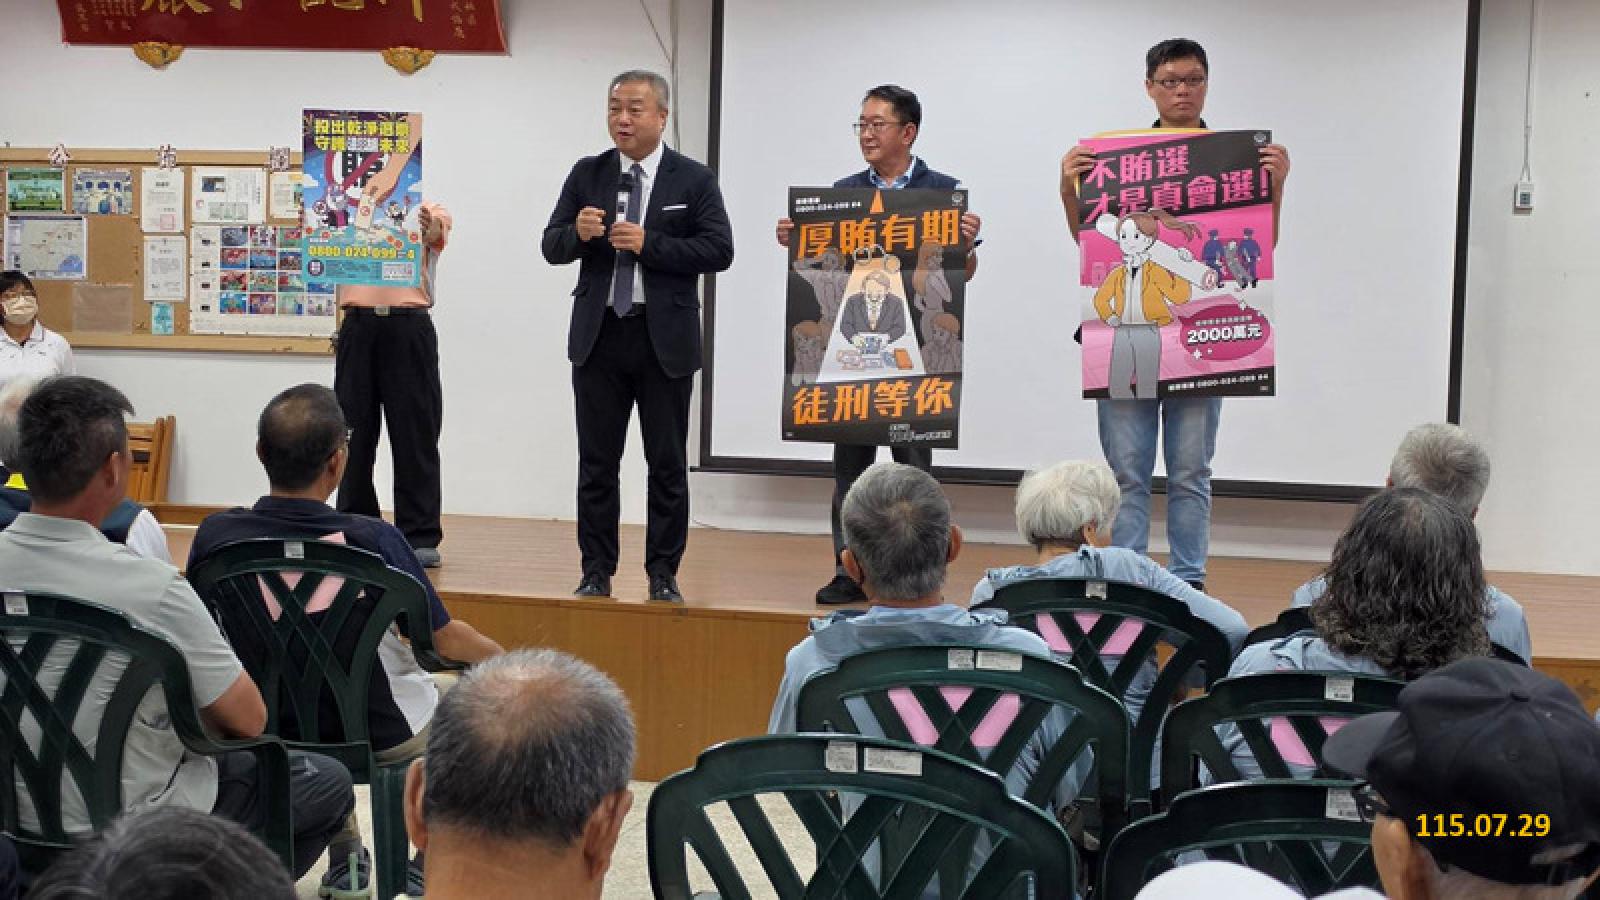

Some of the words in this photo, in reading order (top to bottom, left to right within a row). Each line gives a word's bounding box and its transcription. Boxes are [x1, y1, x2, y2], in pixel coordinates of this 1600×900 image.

[1083, 144, 1190, 189] 不賄選
[798, 209, 959, 259] 厚賄有期
[1187, 323, 1263, 343] 2000萬元
[792, 378, 954, 424] 徒刑等你
